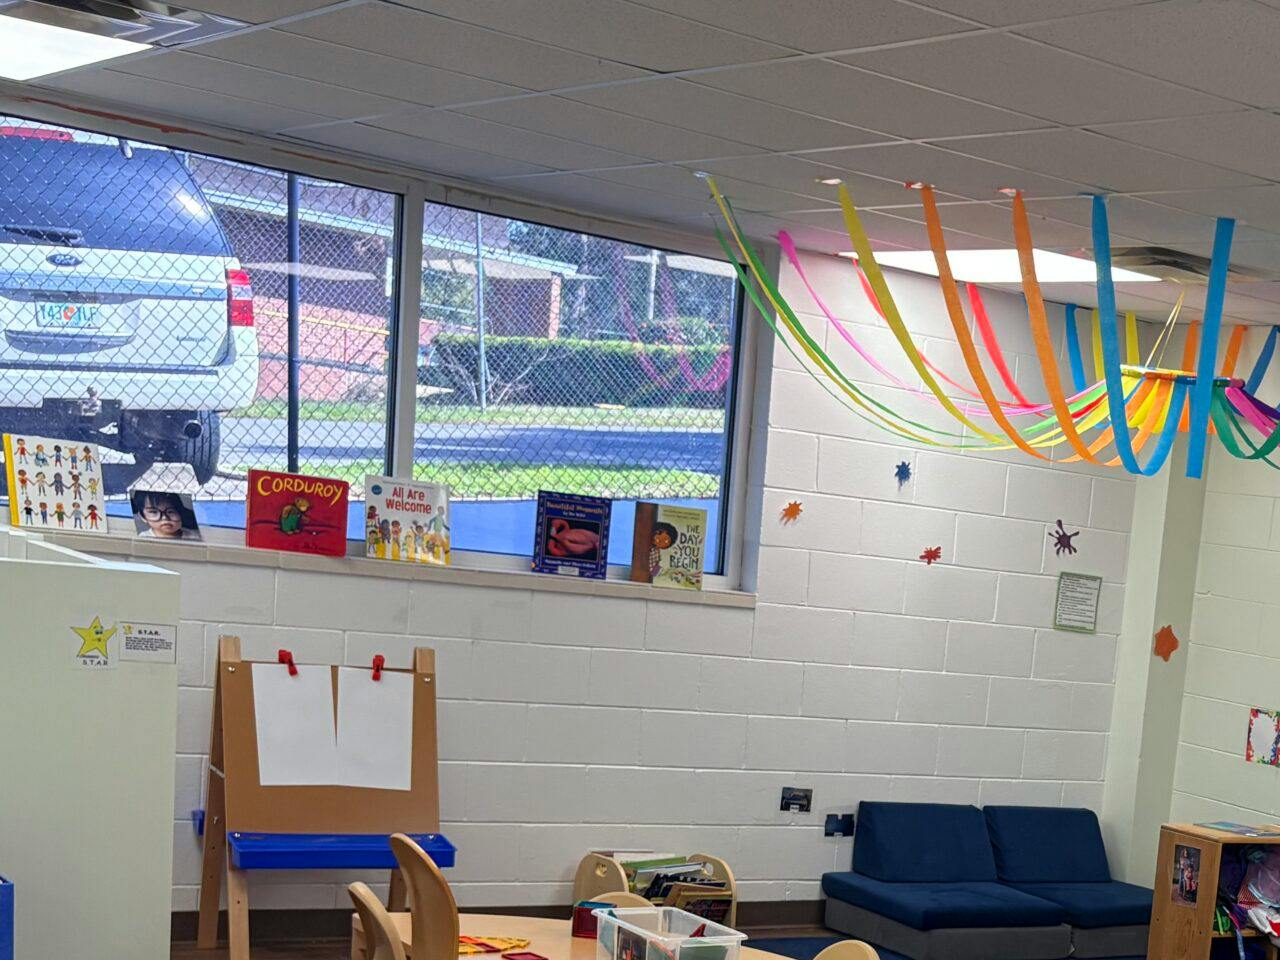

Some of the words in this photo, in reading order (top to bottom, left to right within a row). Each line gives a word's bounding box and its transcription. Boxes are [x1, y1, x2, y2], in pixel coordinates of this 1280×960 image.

[257, 475, 343, 507] CORDUROY
[392, 486, 404, 499] All
[407, 488, 425, 501] Are
[385, 498, 432, 514] Welcome
[680, 532, 700, 545] DAY
[677, 544, 700, 558] YOU
[669, 555, 699, 570] BEGIN
